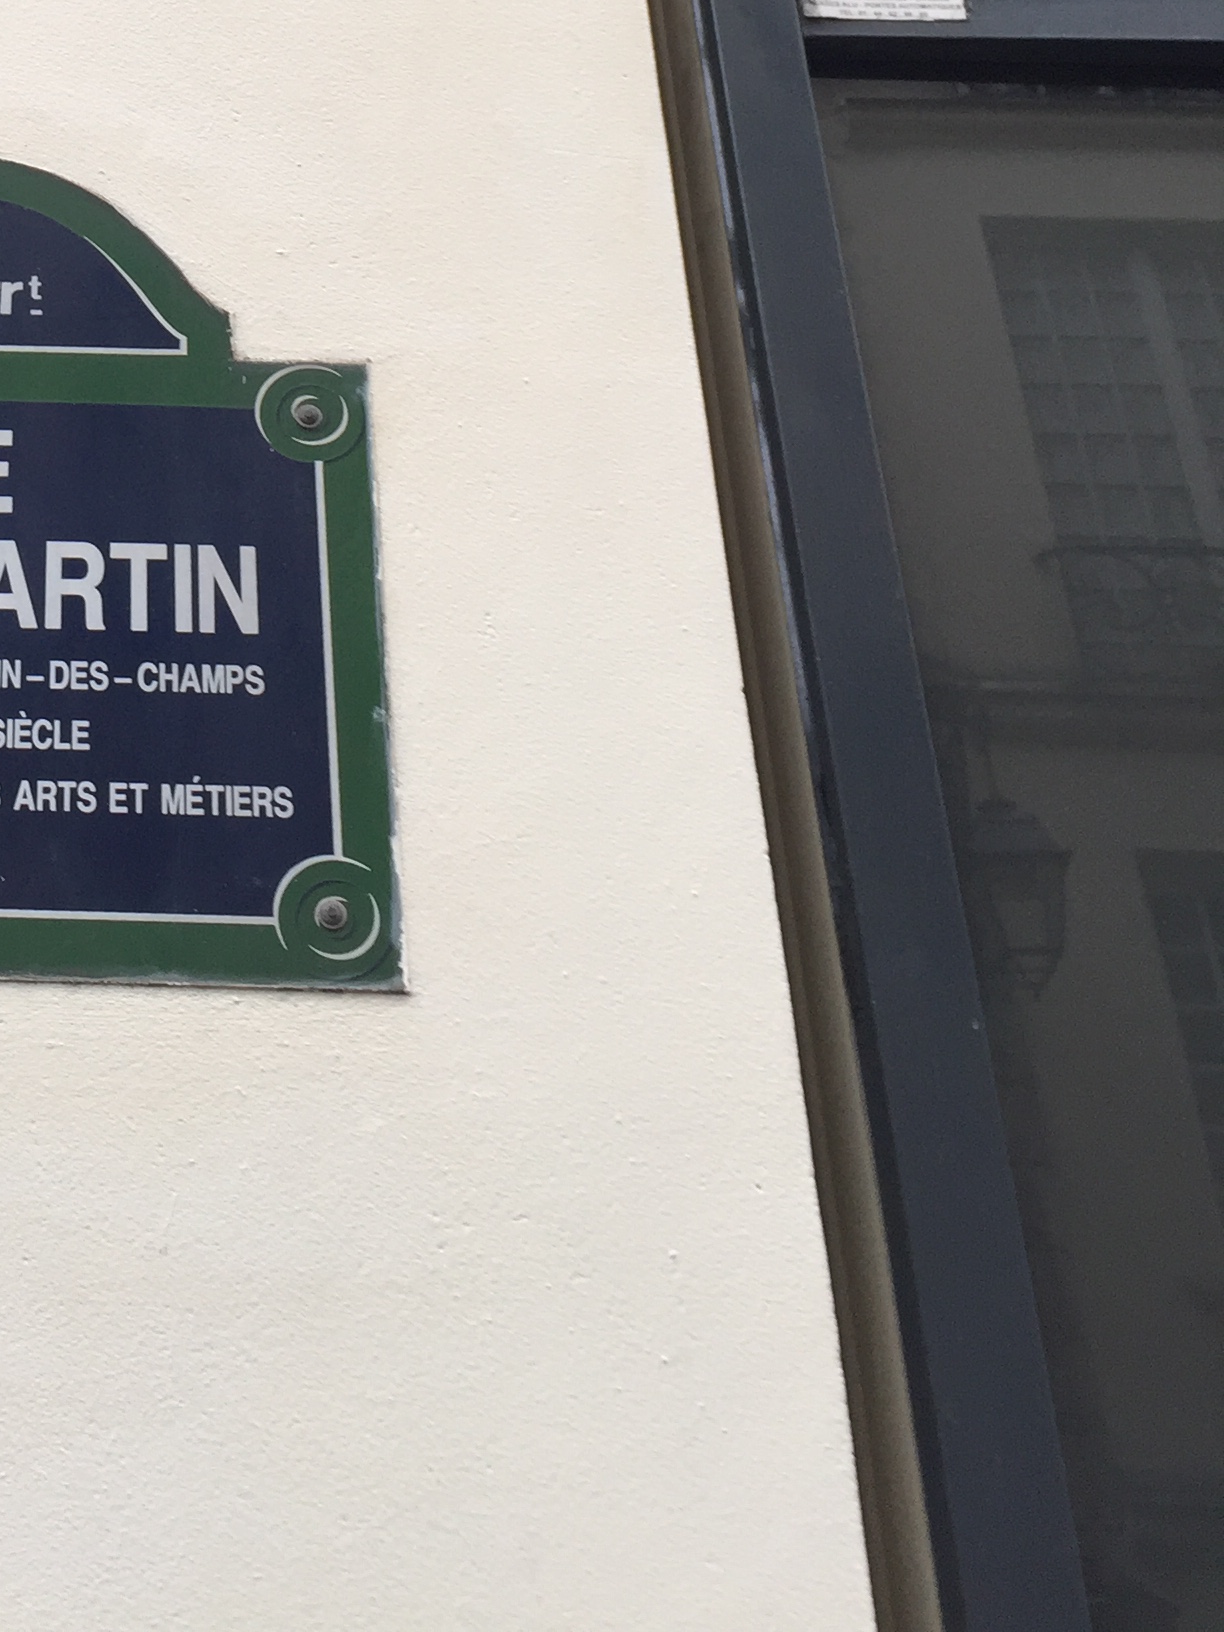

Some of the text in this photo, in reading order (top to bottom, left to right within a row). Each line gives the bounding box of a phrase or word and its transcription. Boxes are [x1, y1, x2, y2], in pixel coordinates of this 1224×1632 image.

[13, 779, 97, 813] ARTS
[109, 782, 149, 814] ET
[161, 775, 294, 819] MÉTIERS
